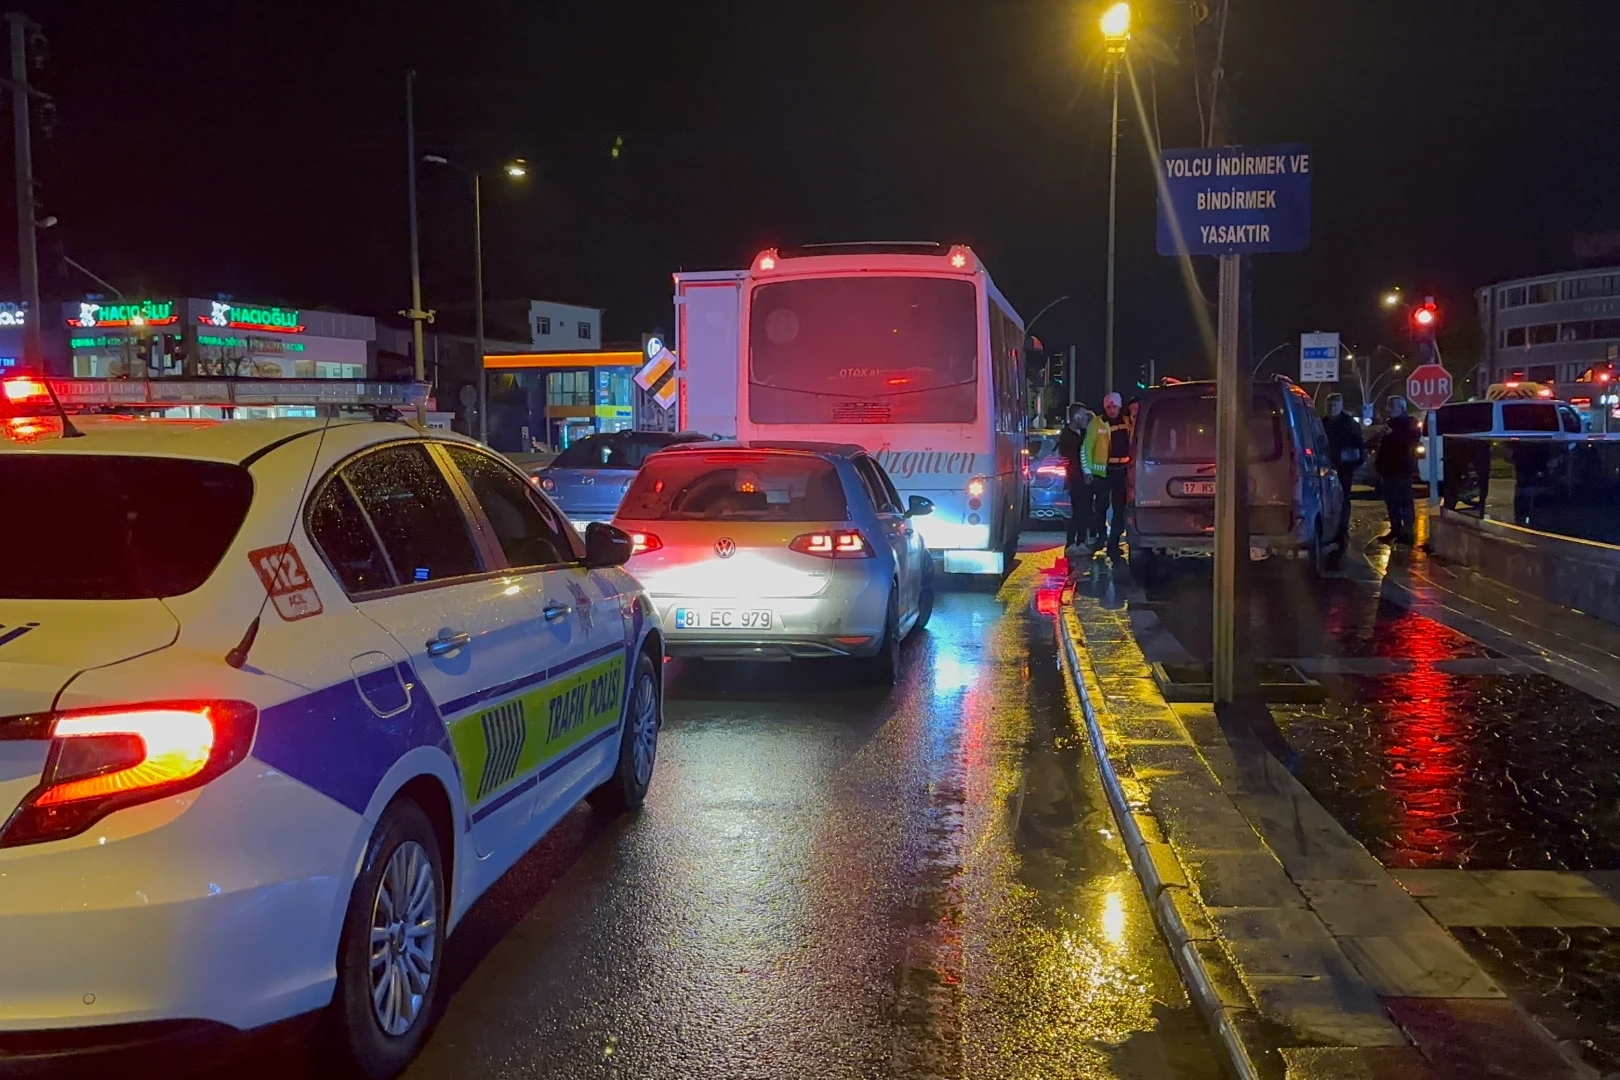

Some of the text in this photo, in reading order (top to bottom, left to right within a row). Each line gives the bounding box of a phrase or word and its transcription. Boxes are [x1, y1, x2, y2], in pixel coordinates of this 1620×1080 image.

[1166, 153, 1309, 177] YOLCU İNDİRMEK VE
[1197, 187, 1276, 210] BİNDİRMEK
[1201, 225, 1270, 243] YASAKTIR
[230, 307, 297, 327] HACIOĞLU
[1411, 377, 1448, 396] DUR
[876, 442, 976, 479] Özgüven
[1185, 483, 1196, 493] 17
[260, 552, 306, 590] 112
[685, 611, 770, 627] 81 EC 979
[546, 659, 621, 744] TRAFİK POLİSİ
